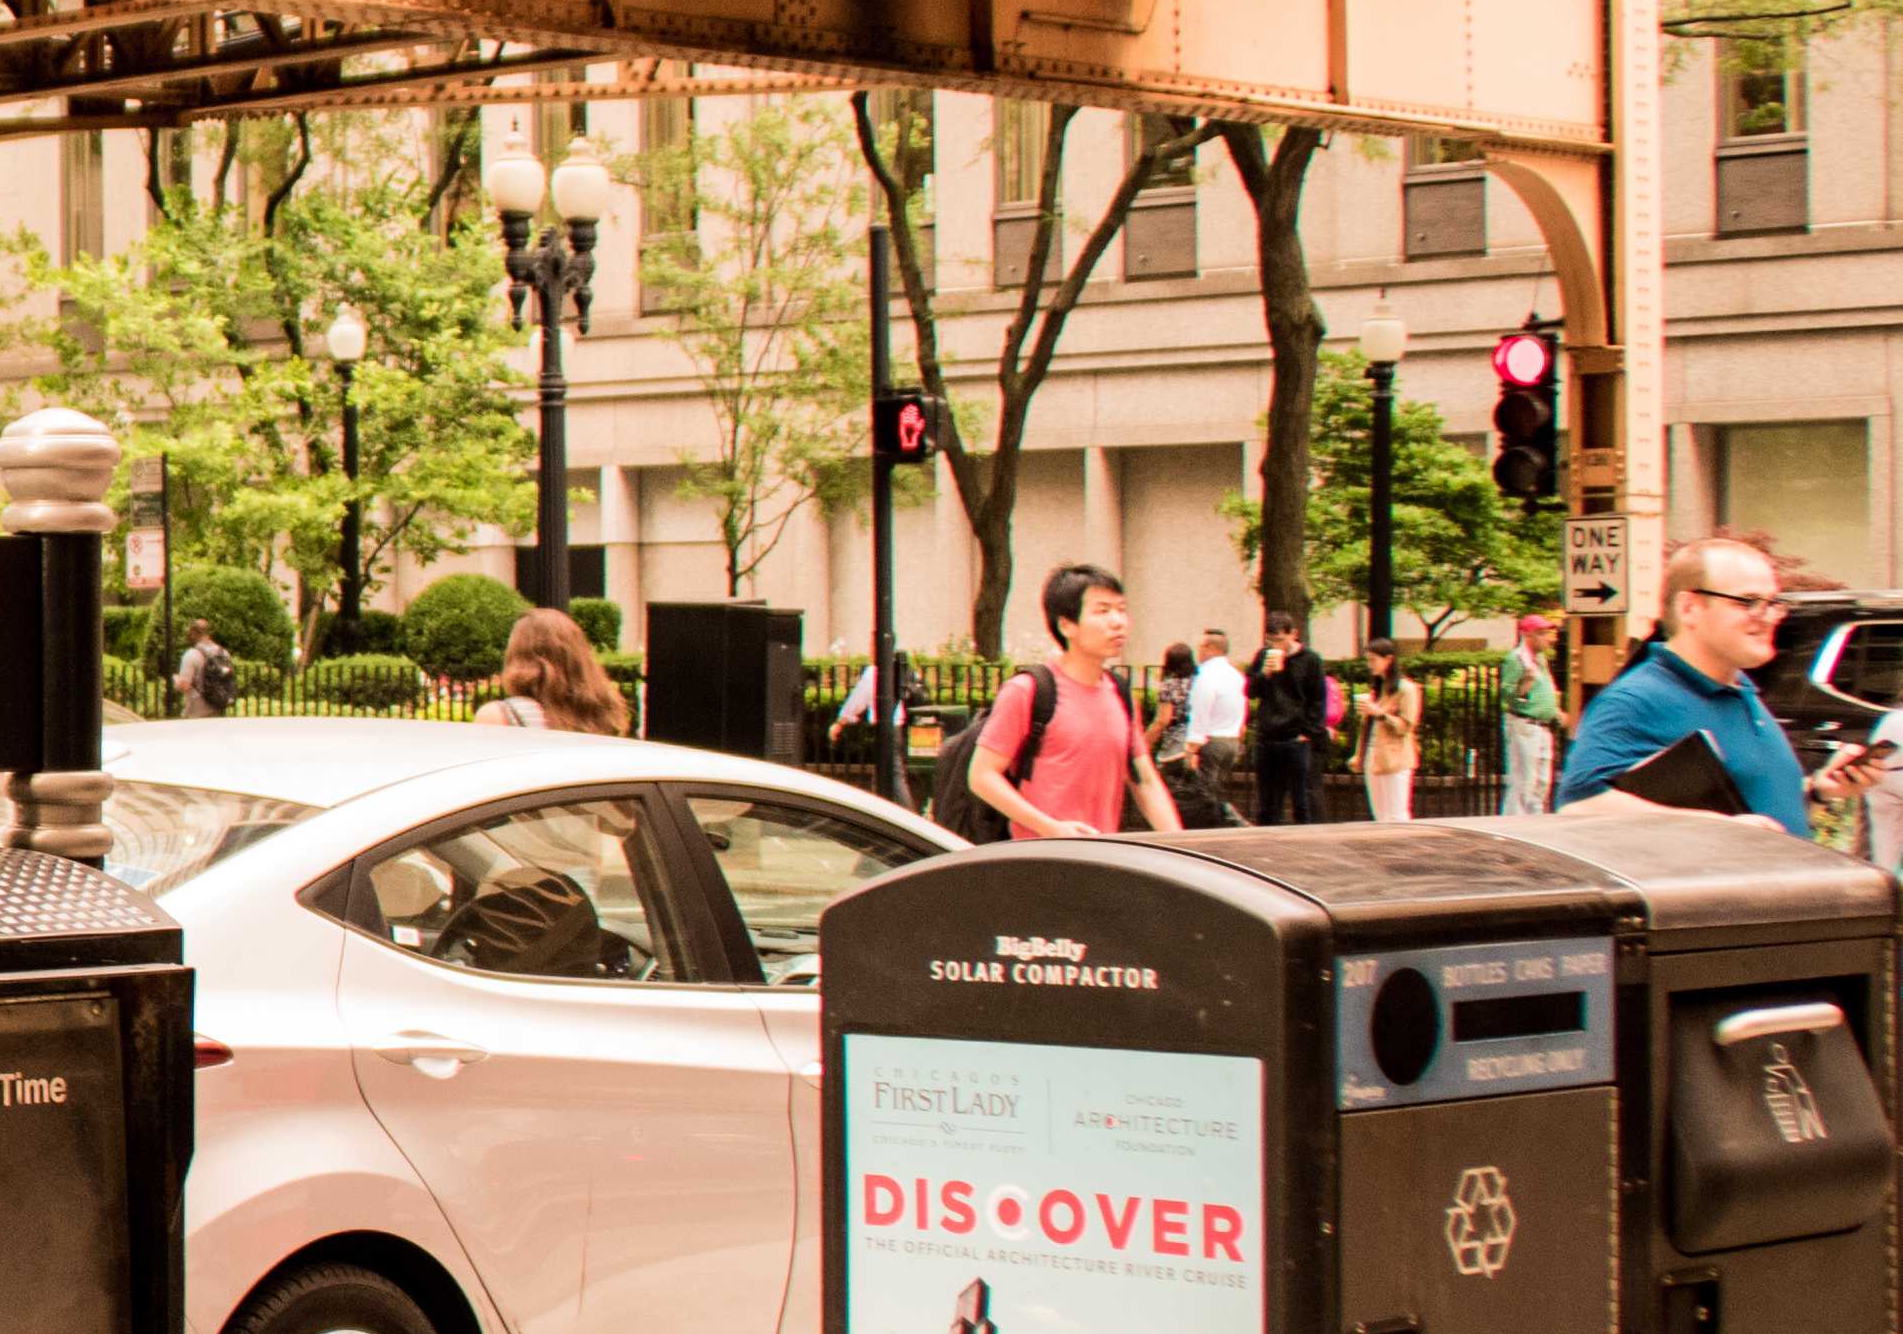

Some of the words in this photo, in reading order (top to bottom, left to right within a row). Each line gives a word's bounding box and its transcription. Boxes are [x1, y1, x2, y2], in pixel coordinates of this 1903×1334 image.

[1572, 526, 1620, 547] ONE
[1571, 554, 1620, 574] WAY
[996, 935, 1088, 961] BigBelly
[930, 960, 1005, 983] SOLAR
[1012, 963, 1159, 989] COMPACTOR
[1442, 961, 1507, 987] BOTTLES
[1562, 952, 1610, 975] PAPER
[1467, 1053, 1545, 1081] RECYCLING
[864, 1172, 1245, 1264] DISCOVER
[865, 1235, 897, 1252] THE
[903, 1240, 980, 1261] OFFICIAL
[986, 1248, 1119, 1275] ARCHITECTURE
[1125, 1261, 1177, 1282] RIVER
[1183, 1269, 1247, 1291] CRUISE
